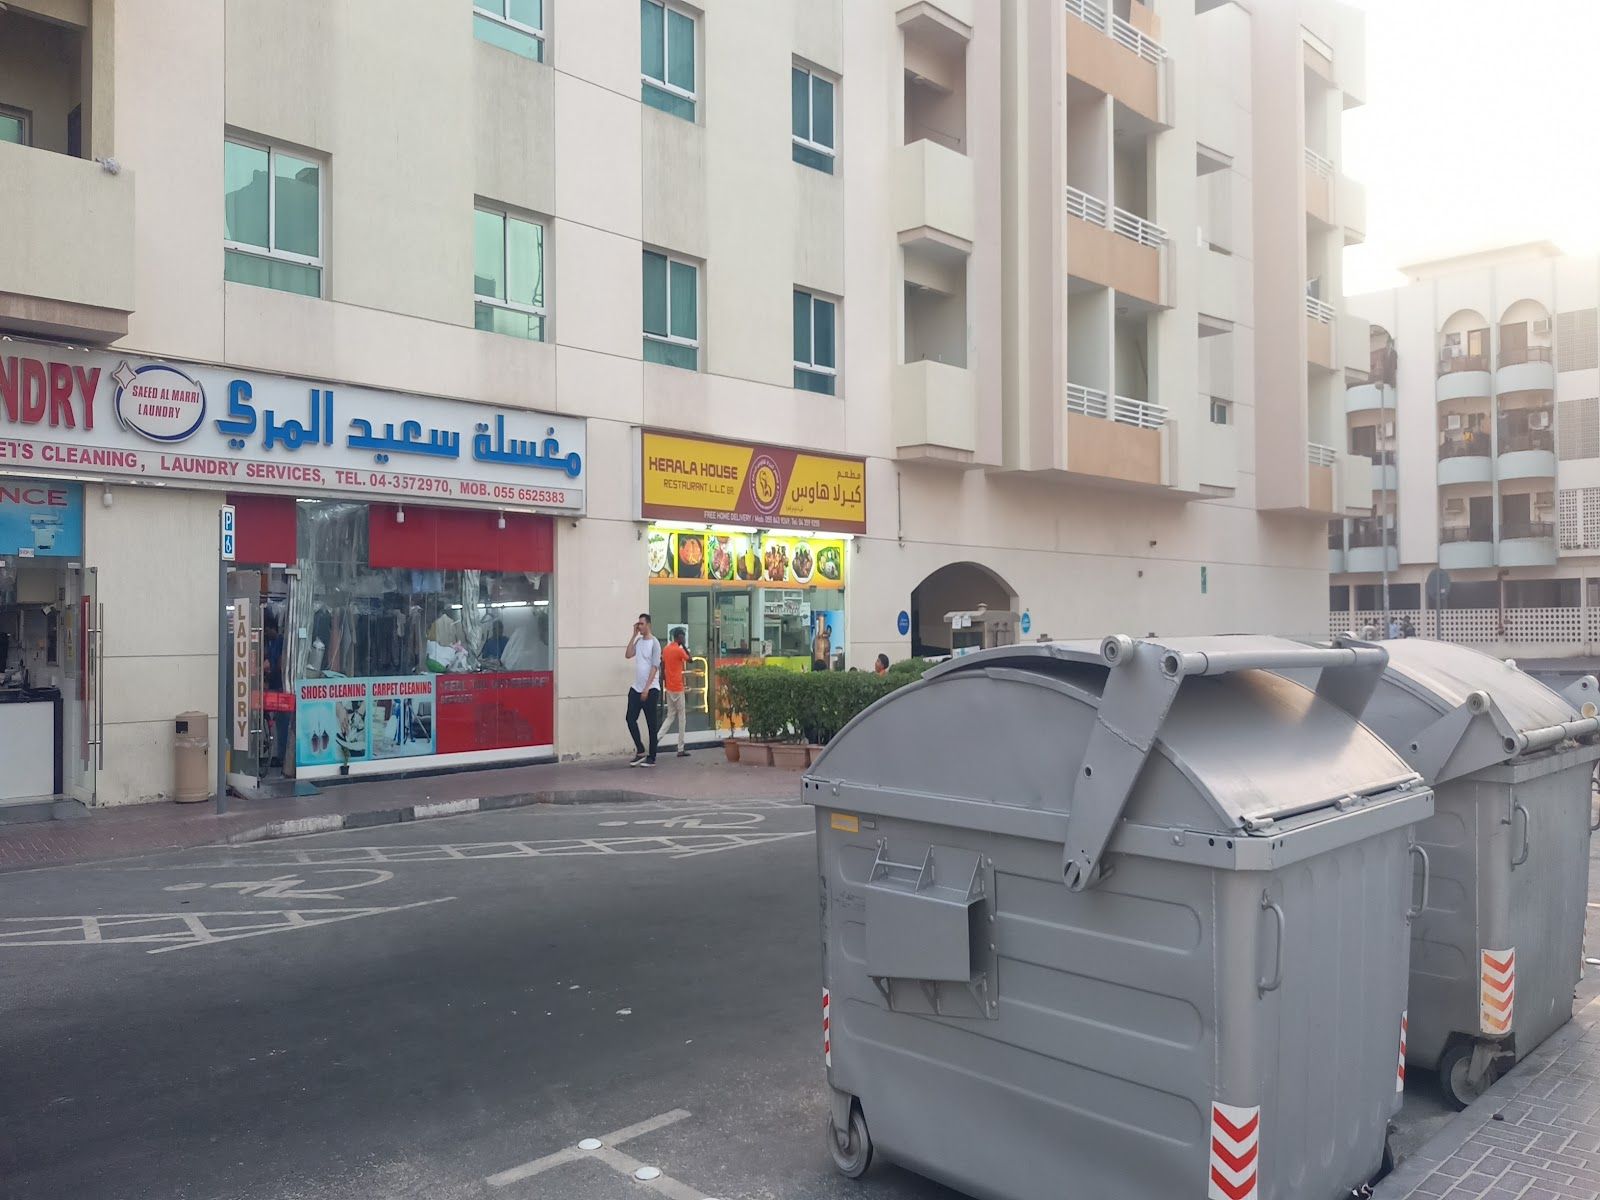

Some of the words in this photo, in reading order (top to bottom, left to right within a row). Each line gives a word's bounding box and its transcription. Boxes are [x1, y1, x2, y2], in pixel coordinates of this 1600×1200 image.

[132, 385, 158, 398] SAEED
[160, 388, 169, 400] AL
[172, 390, 200, 404] MARRI
[138, 404, 180, 418] LAUNDRY
[214, 379, 334, 451] المري
[346, 418, 460, 464] سعيد
[472, 414, 581, 478] مغسلة
[160, 456, 239, 476] LAUNDRY
[246, 463, 326, 486] SERVICES,
[336, 470, 366, 486] TEL.
[370, 473, 452, 496] 04-3572970,
[460, 482, 490, 496] MOB.
[494, 486, 514, 499] 055
[518, 488, 565, 503] 6525383
[700, 462, 738, 480] HOUSE
[664, 478, 708, 492] RESTAURANT
[792, 482, 830, 504] هاوس
[226, 512, 232, 530] P
[704, 510, 716, 520] FREE
[717, 512, 730, 520] HOME
[731, 513, 752, 522] DELIVERY
[236, 604, 247, 737] LAUNDRY
[301, 685, 327, 700] SHOES
[329, 683, 366, 698] CLEANING
[372, 682, 398, 696] CARPET
[400, 681, 432, 694] CLEANING
